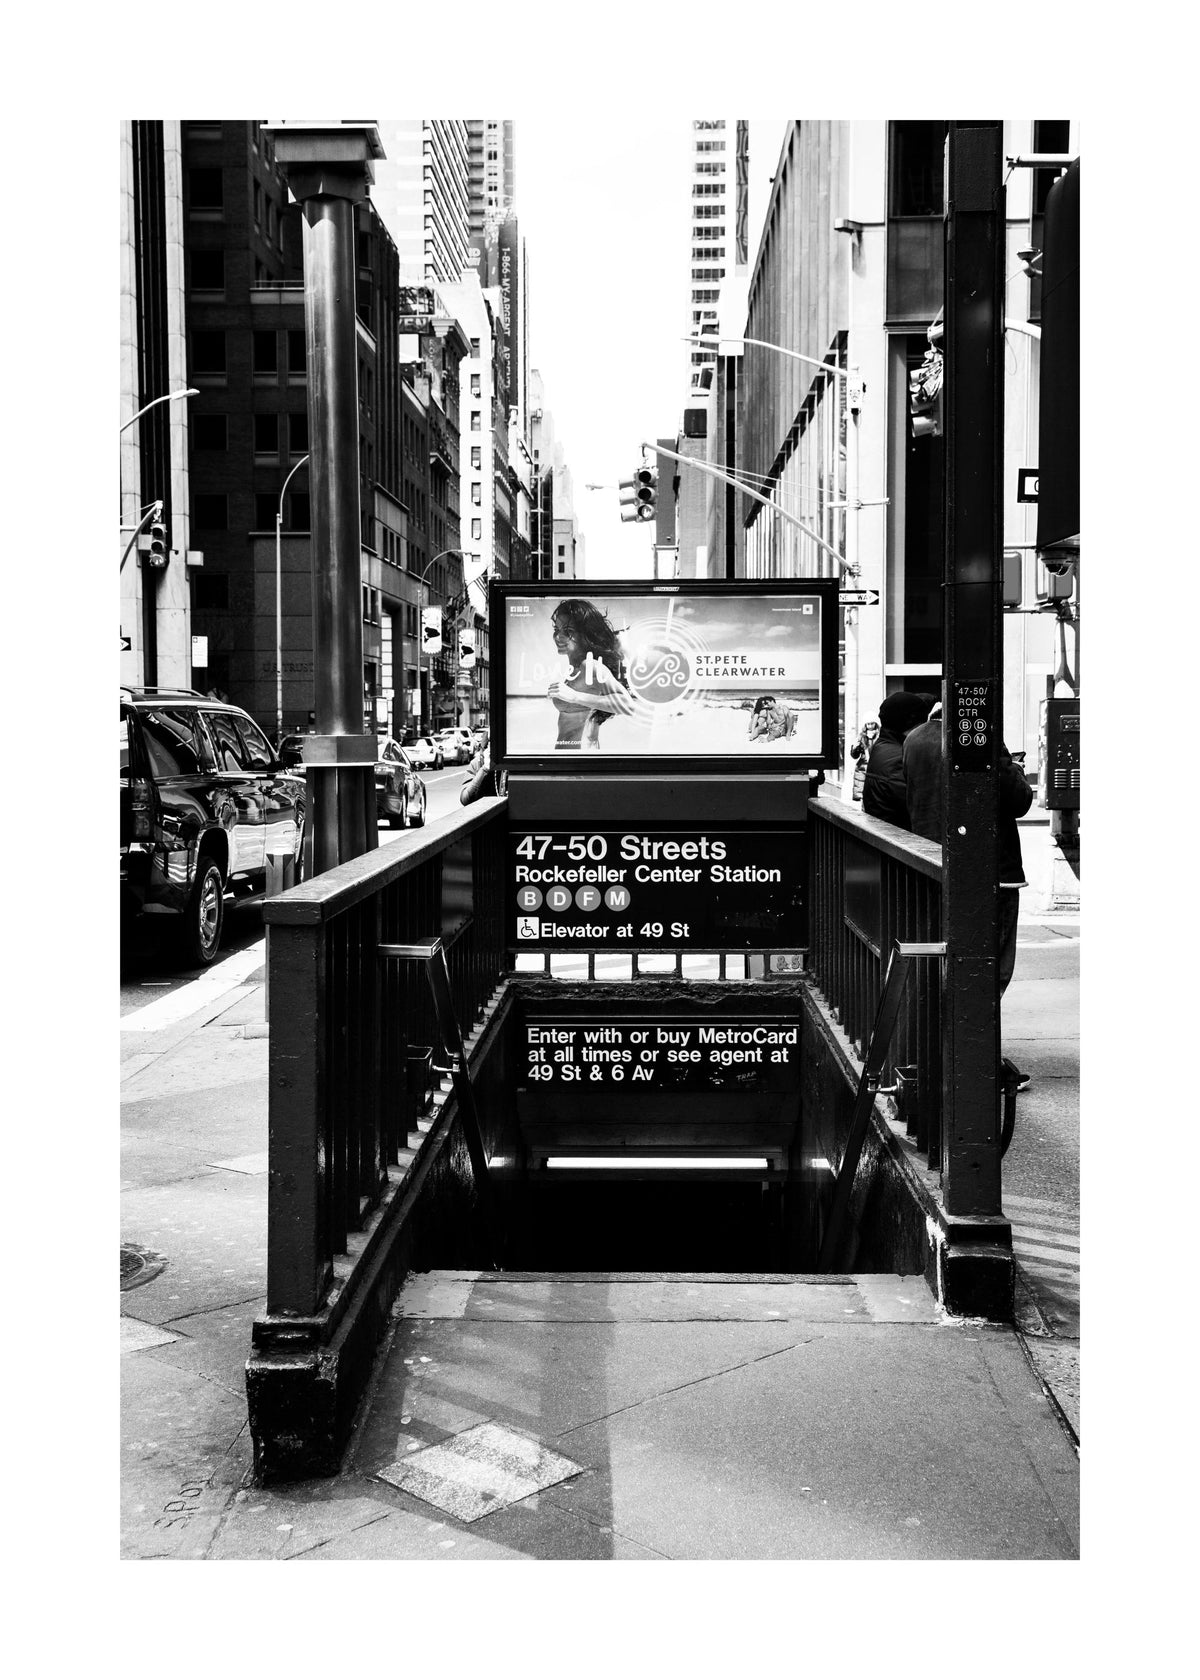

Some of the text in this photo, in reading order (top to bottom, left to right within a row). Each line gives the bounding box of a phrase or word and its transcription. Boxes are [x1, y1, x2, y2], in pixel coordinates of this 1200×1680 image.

[696, 655, 748, 665] ST.PETE
[696, 667, 786, 677] CLEARWATER
[958, 687, 988, 696] 47-50/
[958, 697, 987, 706] ROCK
[958, 708, 978, 717] CTR
[516, 835, 727, 860] 47-50 Streets
[516, 865, 781, 882] Rockefeller Center Station
[541, 923, 690, 938] Elevator at 49 St
[527, 1028, 797, 1046] Enter with or buy MetroCard
[528, 1047, 789, 1066] at all times or see agent at
[528, 1065, 654, 1081] 49 St & 6 Av
